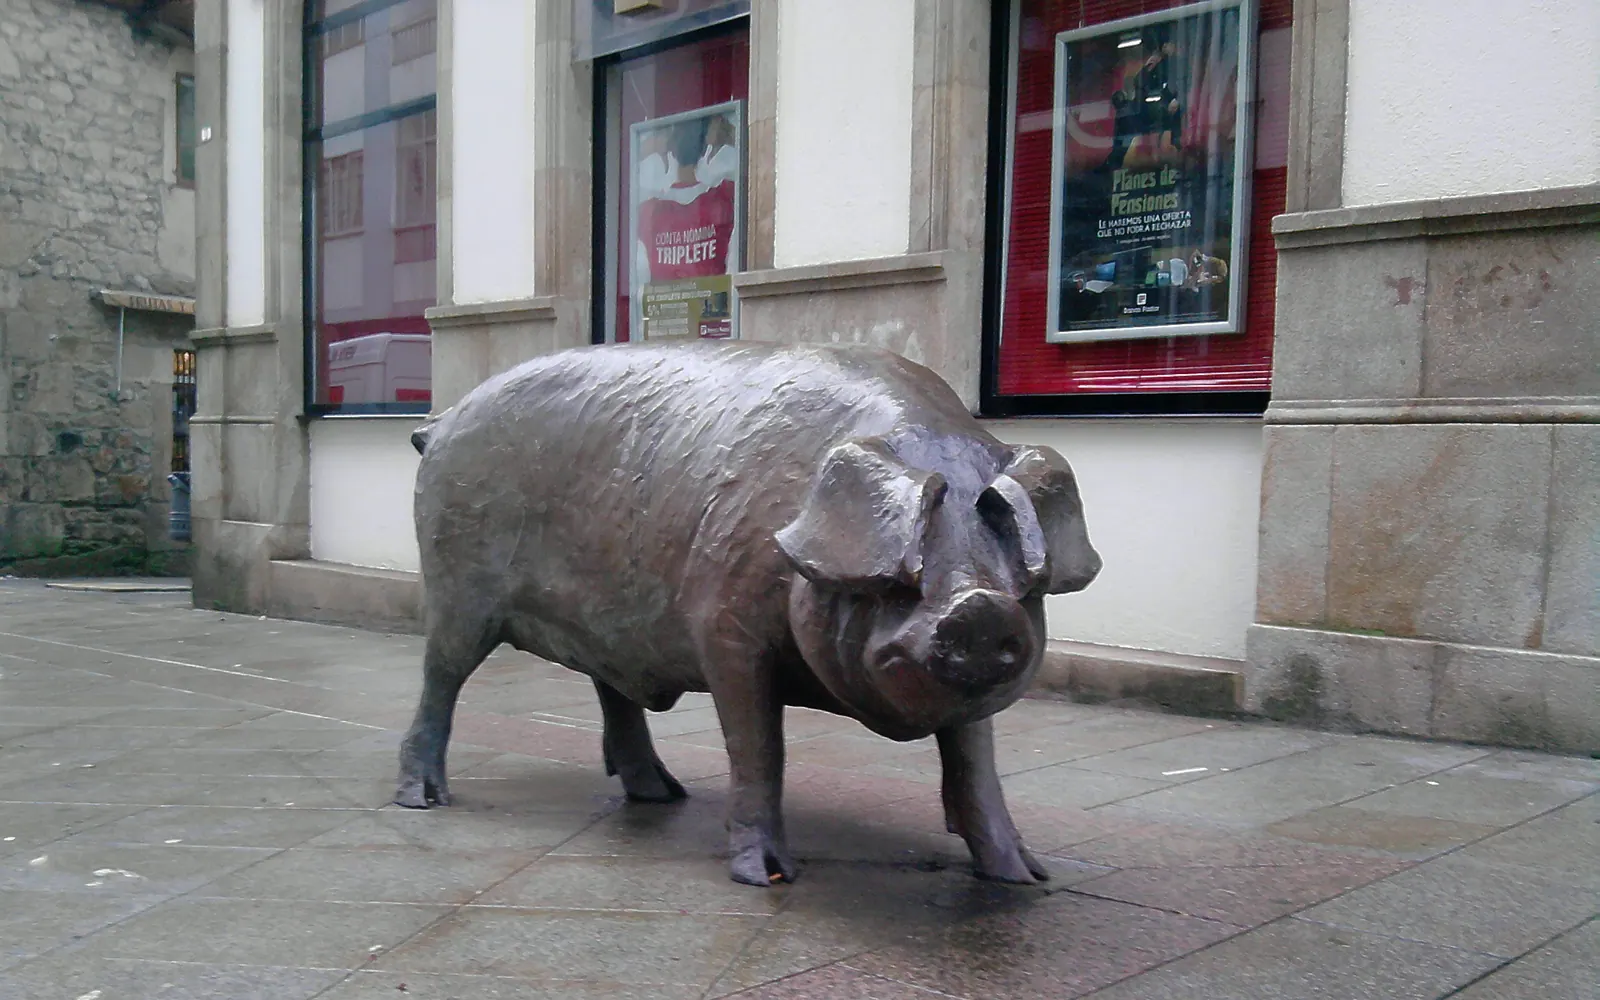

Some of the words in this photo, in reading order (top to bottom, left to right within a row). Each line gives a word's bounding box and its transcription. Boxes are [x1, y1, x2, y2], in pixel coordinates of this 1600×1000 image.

[1112, 168, 1157, 192] Planes
[1160, 164, 1179, 186] de
[1111, 192, 1179, 217] Pensiones
[1097, 229, 1112, 238] QUE
[1114, 227, 1126, 236] NO
[1151, 219, 1192, 232] RECHAZAR
[1108, 216, 1142, 228] HAREMOS
[1144, 214, 1160, 224] UNA
[1161, 211, 1191, 221] OFERTA
[656, 239, 717, 265] TRIPLETE
